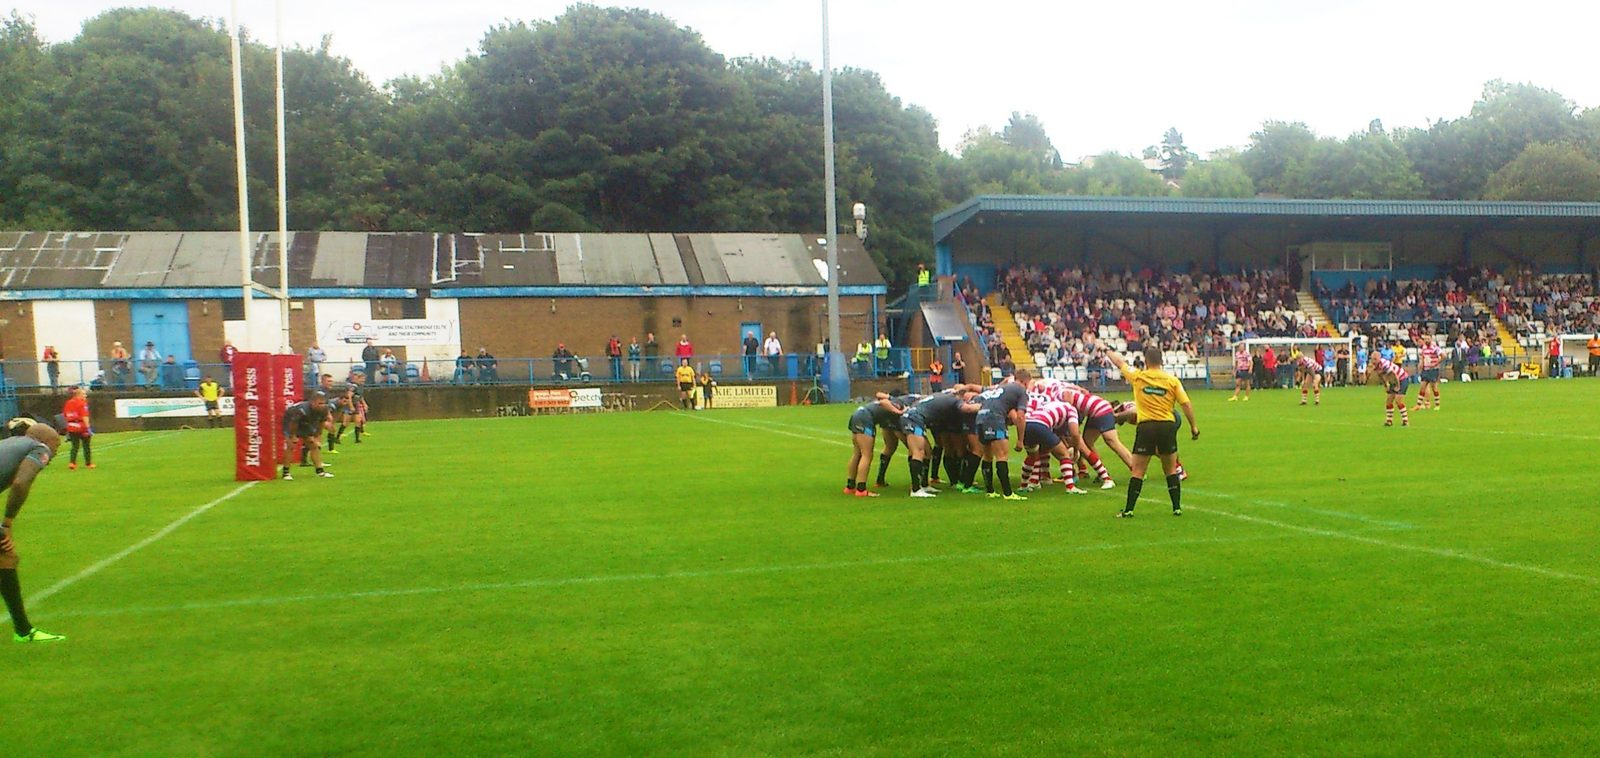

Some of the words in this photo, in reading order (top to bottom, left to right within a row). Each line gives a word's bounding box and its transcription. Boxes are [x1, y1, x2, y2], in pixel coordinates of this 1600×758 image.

[245, 367, 259, 401] Press
[283, 367, 295, 396] Press
[735, 387, 773, 396] LIMITED
[245, 405, 262, 467] Kingstone
